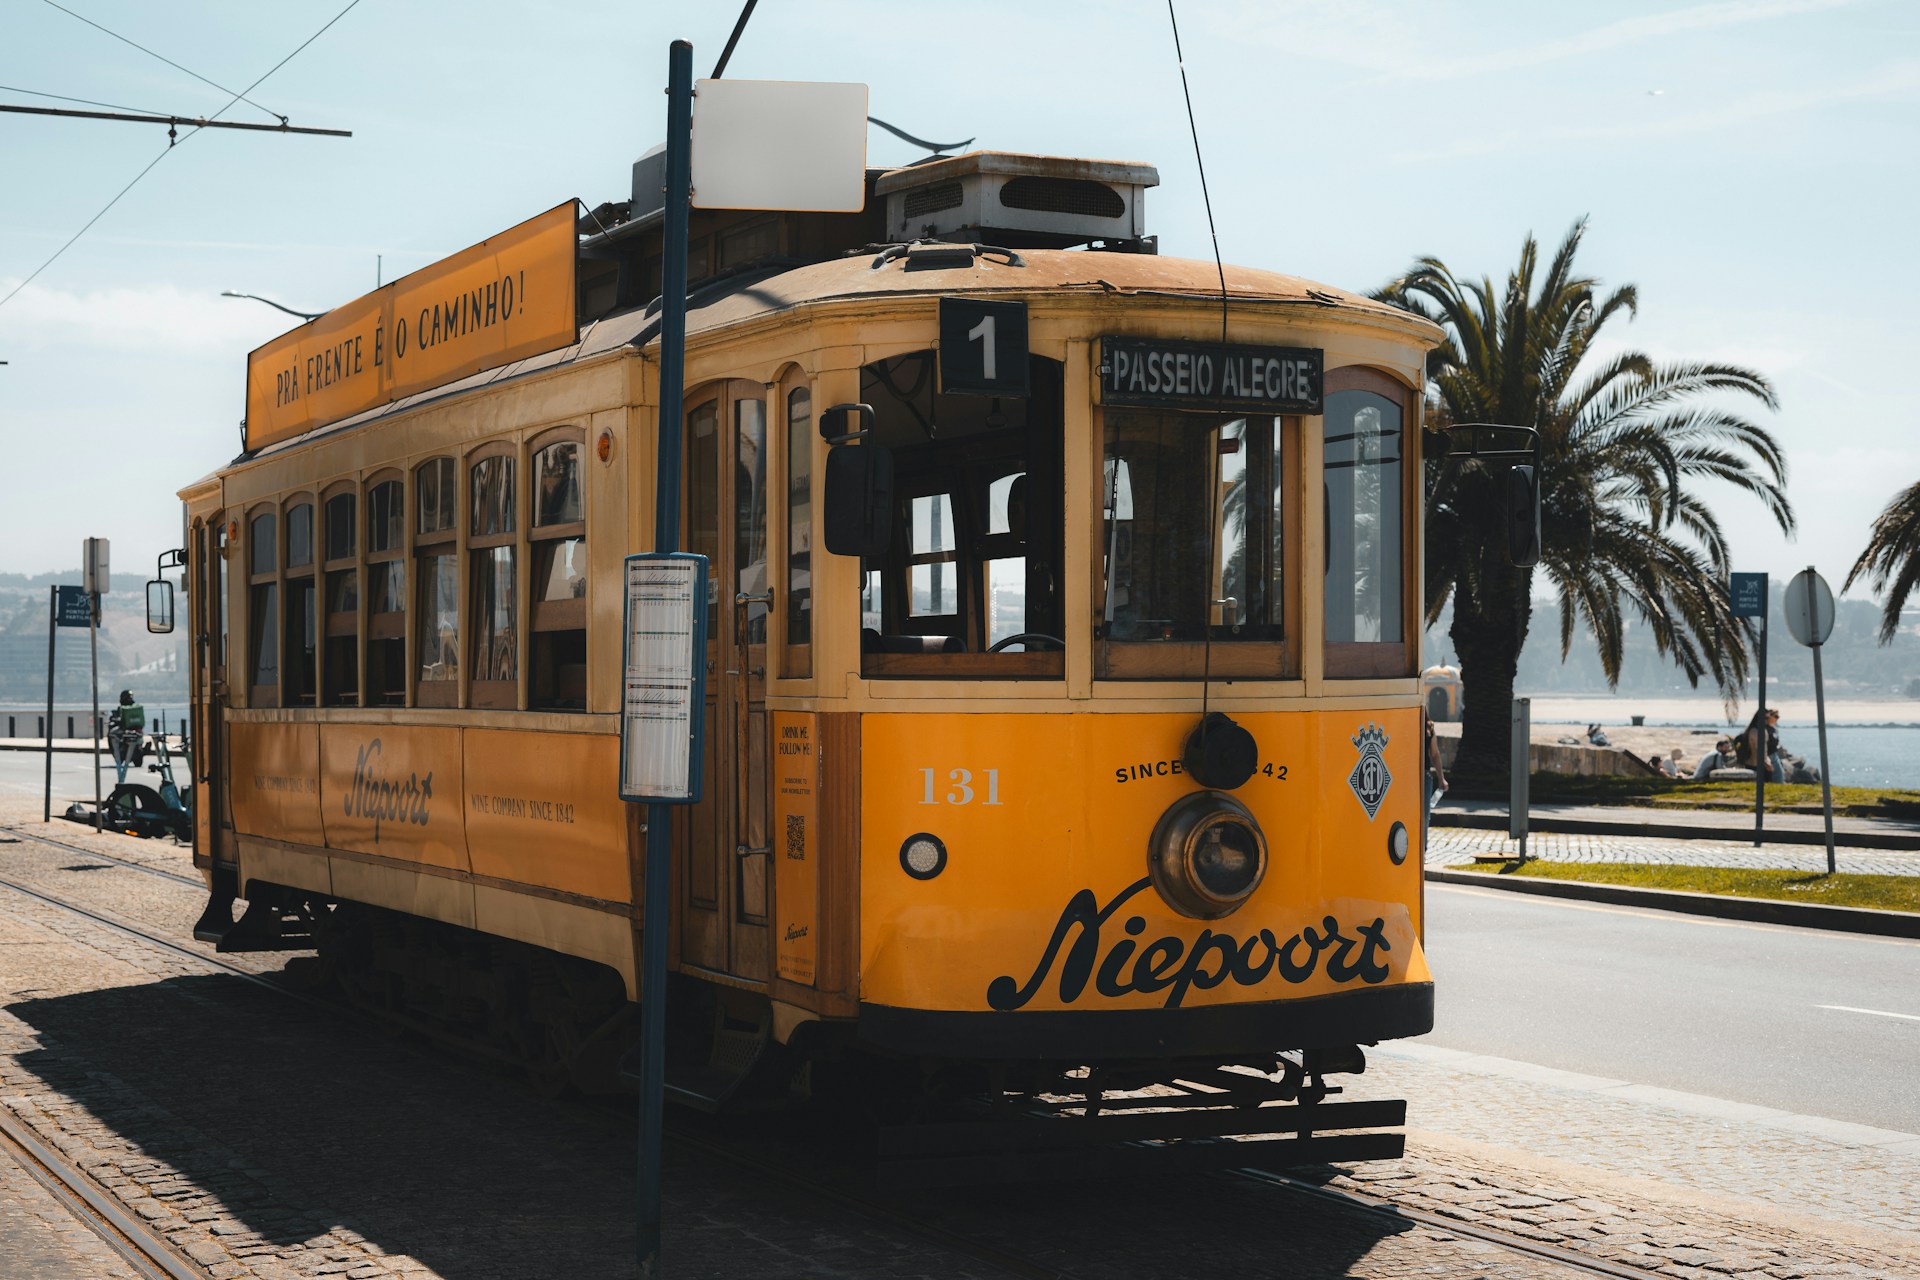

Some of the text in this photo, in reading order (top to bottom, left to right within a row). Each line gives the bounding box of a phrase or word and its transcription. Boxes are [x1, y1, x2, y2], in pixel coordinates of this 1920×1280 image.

[276, 270, 525, 408] PRÁ FRENTE É O CAMINHO!
[968, 314, 997, 380] 1
[1113, 349, 1311, 401] PASSEIO ALEGRE
[779, 743, 801, 755] FOLLOW
[782, 726, 798, 739] DRINK
[343, 737, 433, 845] Niepoort
[916, 767, 1004, 805] 131
[1115, 759, 1288, 783] SINCE 42
[471, 793, 574, 824] WINE COMPANY SINCE 1842
[986, 875, 1392, 1011] Niepoort
